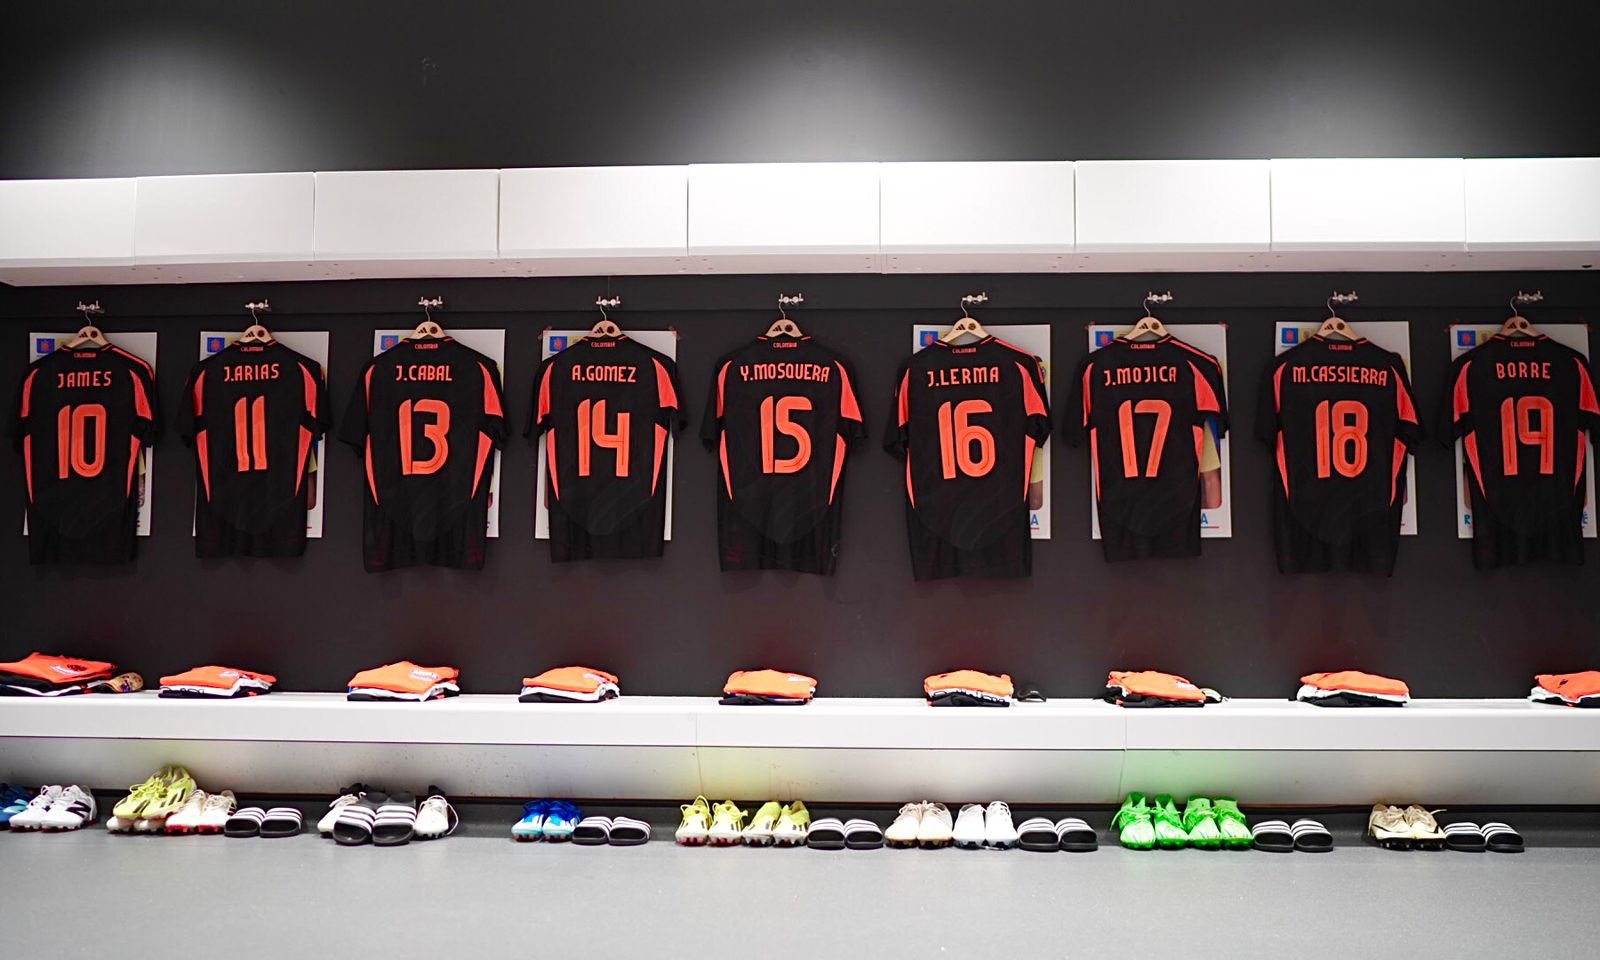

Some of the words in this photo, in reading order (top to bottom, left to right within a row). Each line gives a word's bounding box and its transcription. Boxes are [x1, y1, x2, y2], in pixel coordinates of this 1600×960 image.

[58, 370, 112, 388] JAMES
[224, 363, 280, 382] J.ARIAS
[396, 364, 452, 382] J.CABAL
[572, 364, 638, 384] A.GOMEZ
[740, 362, 832, 383] Y.MOSQUERA
[928, 367, 1000, 387] J.LERMA
[1105, 365, 1178, 387] J.MOJICA
[1293, 365, 1388, 386] M.CASSIERRA
[1496, 362, 1551, 379] BORRE
[58, 404, 107, 479] 10
[235, 396, 268, 472] 11
[399, 399, 450, 475] 13
[577, 400, 630, 477] 14
[761, 396, 813, 474] 15
[938, 400, 996, 480] 16
[1119, 400, 1172, 478] 17
[1316, 400, 1369, 479] 18
[1501, 396, 1554, 476] 19
